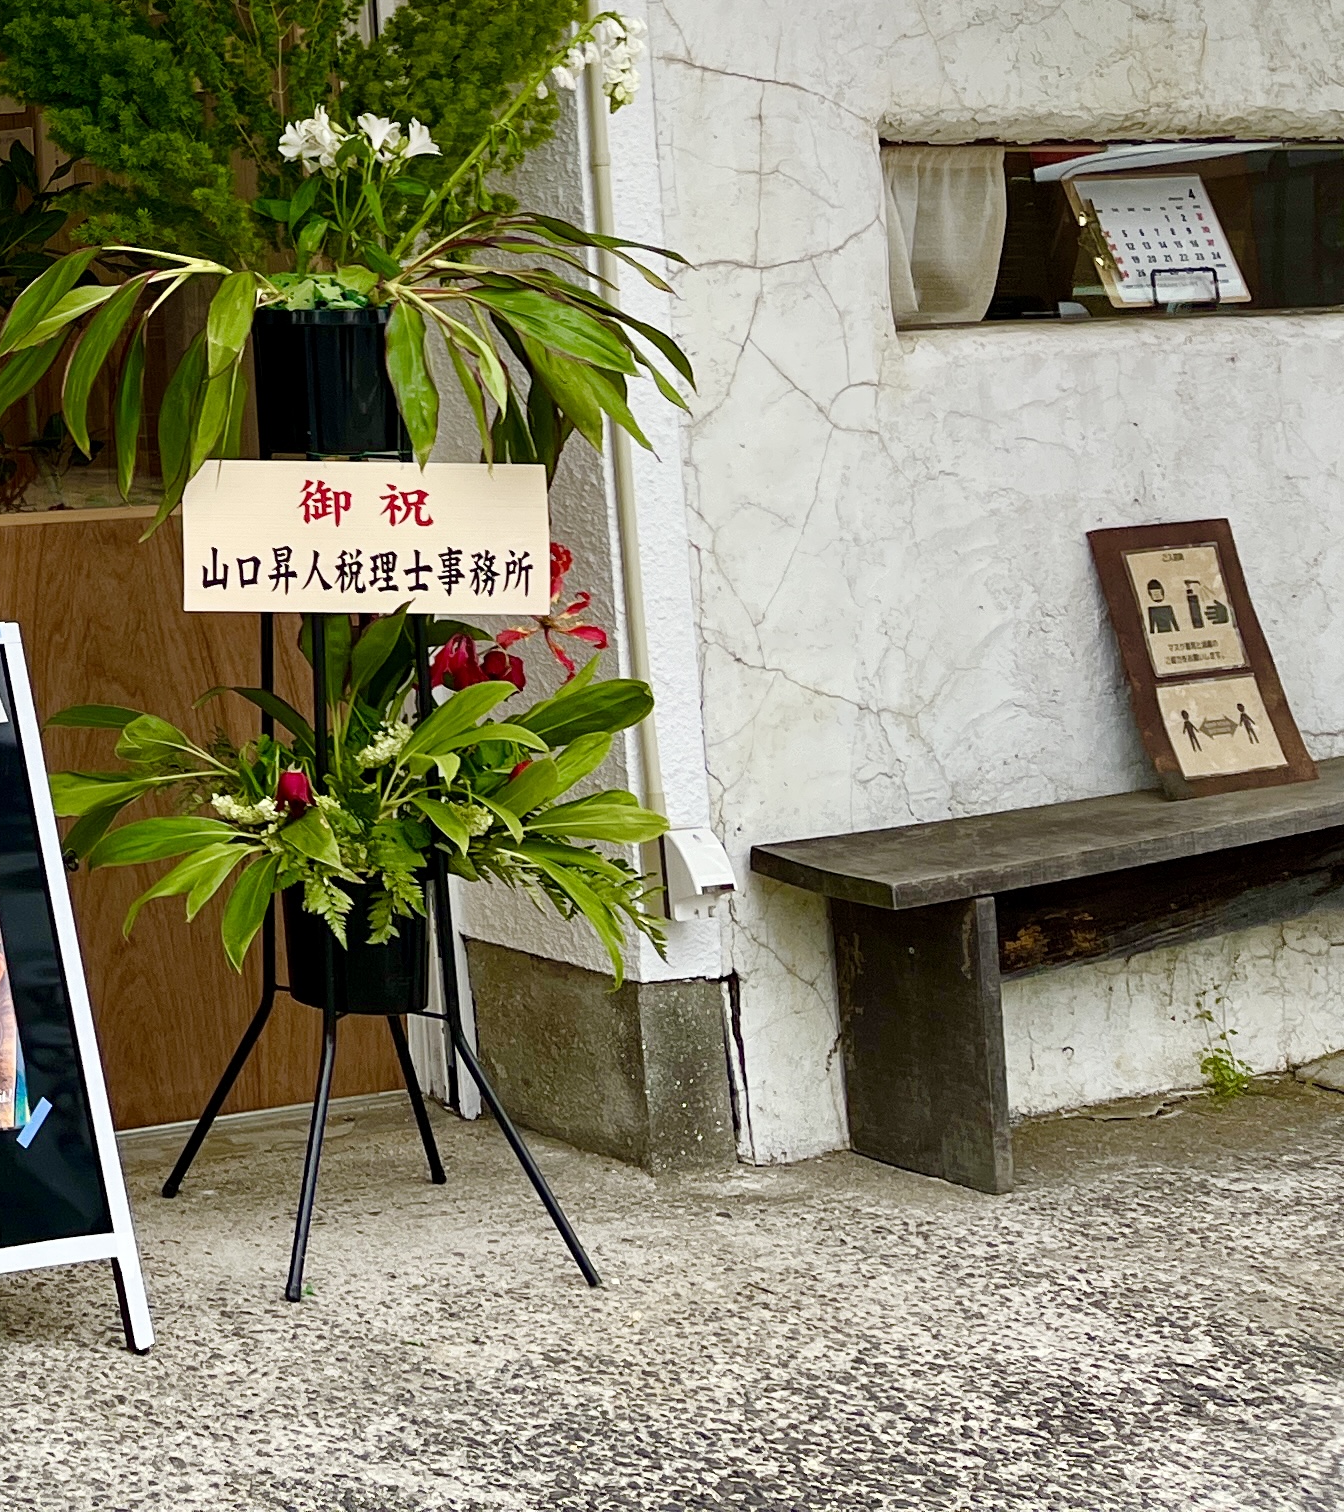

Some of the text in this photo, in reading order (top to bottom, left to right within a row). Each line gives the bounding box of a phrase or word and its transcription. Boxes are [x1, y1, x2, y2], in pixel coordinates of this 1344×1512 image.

[298, 479, 435, 528] 御祝
[202, 545, 535, 598] 山口昇人税理士事務所
